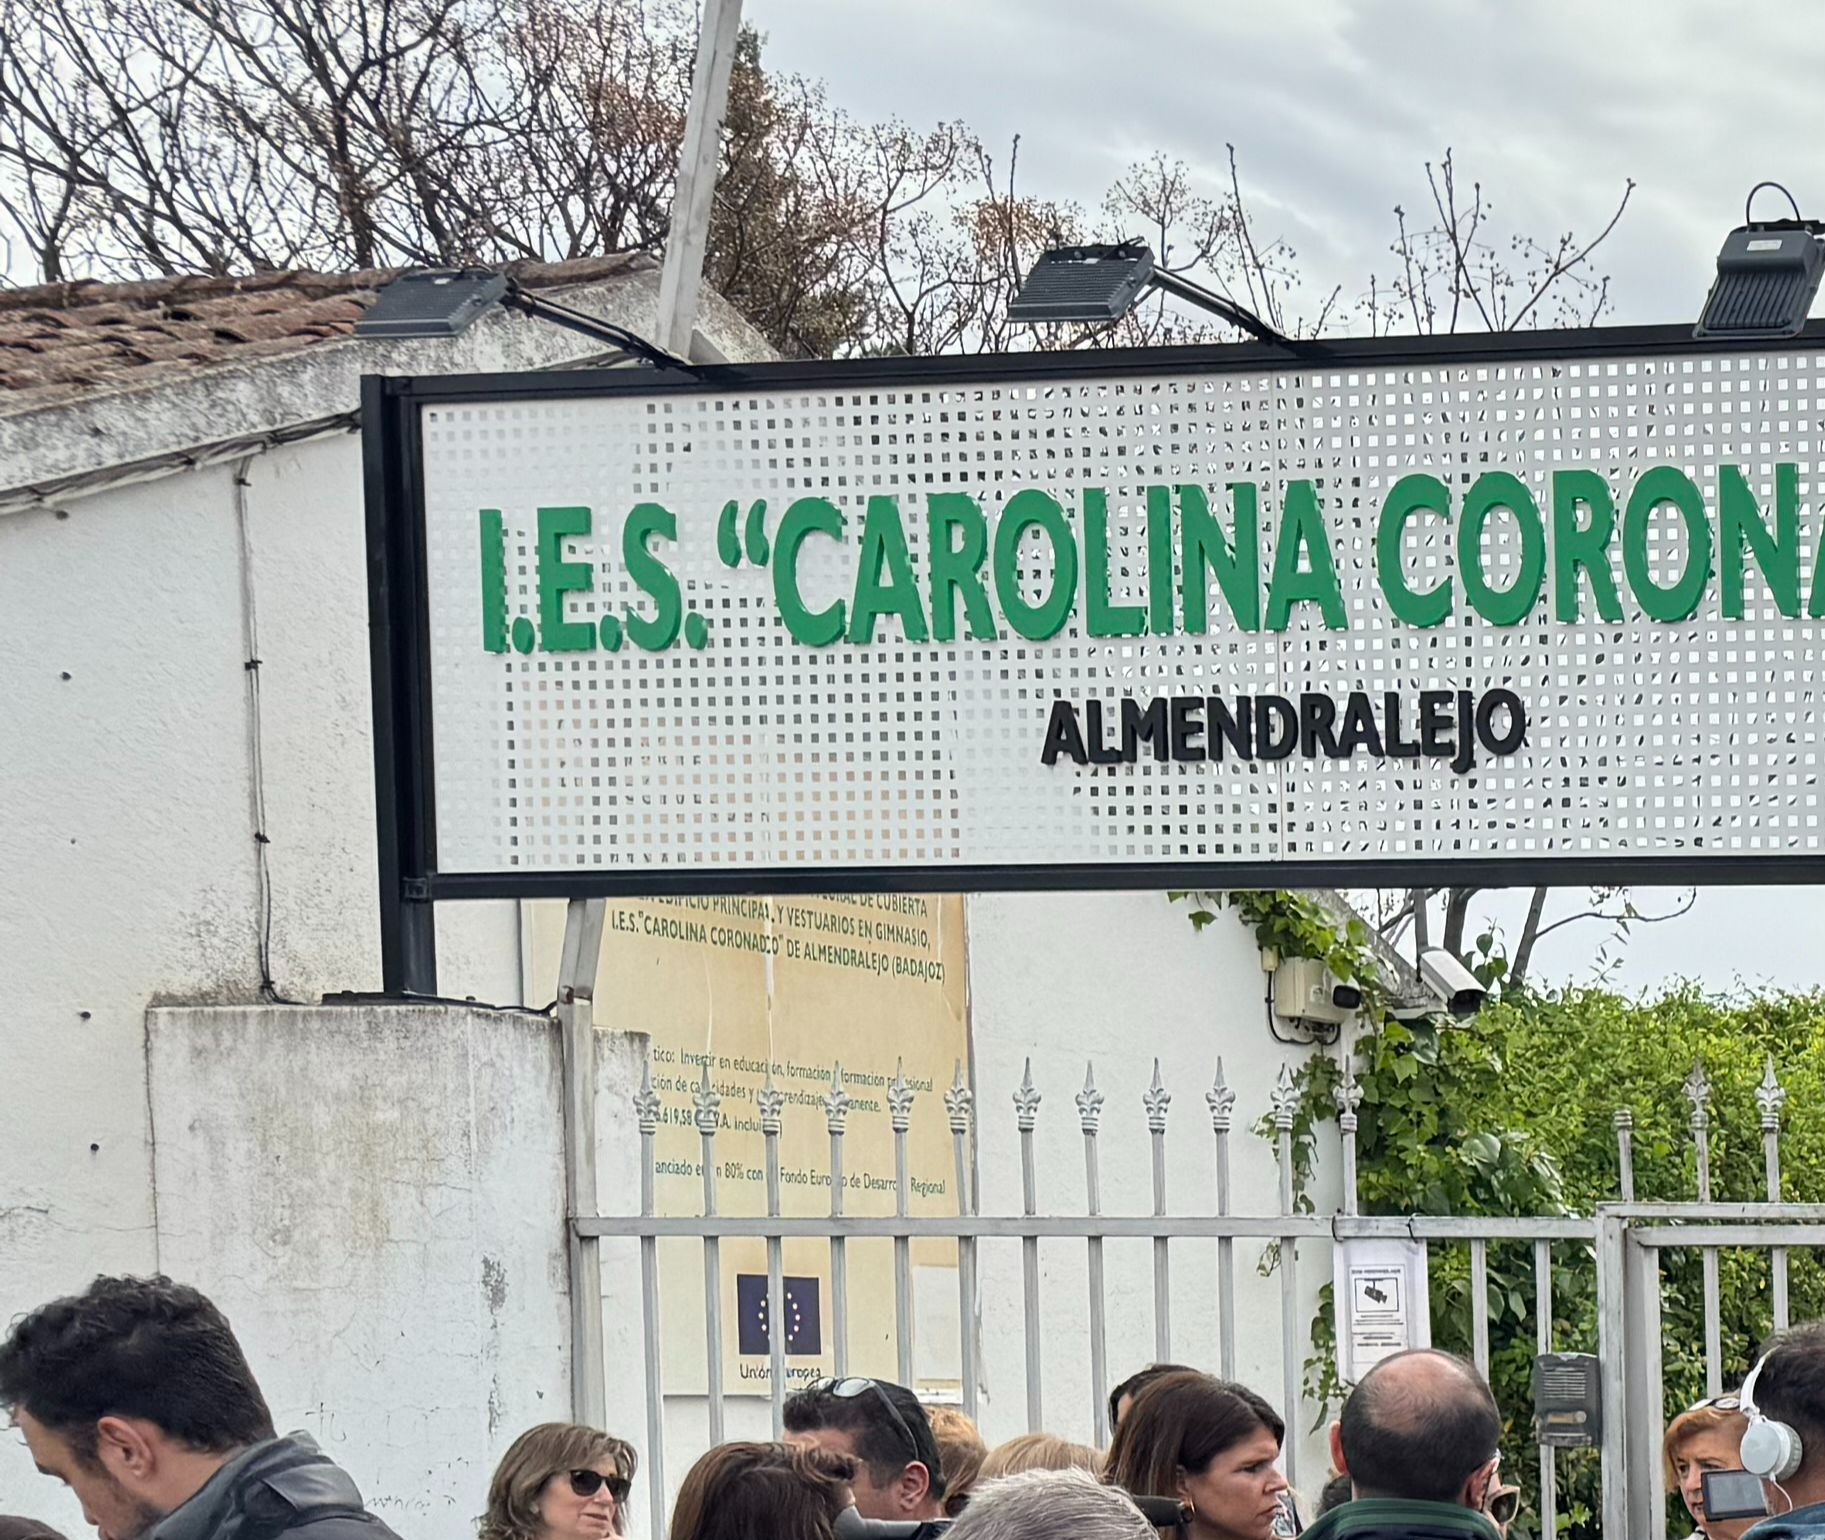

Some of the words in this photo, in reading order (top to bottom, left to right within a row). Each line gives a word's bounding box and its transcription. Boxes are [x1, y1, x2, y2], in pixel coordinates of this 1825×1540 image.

[479, 501, 709, 654] I.E.S.
[1040, 687, 1528, 774] ALMENDRALEJO
[876, 894, 928, 918] CUBIERTA
[612, 909, 640, 933] I.E.S.
[787, 939, 800, 958] DE
[804, 942, 889, 976] ALMENDRALEJO
[892, 955, 946, 985] (BADAJOZ)
[787, 906, 855, 935] VESTUARIOS
[858, 919, 872, 938] EN
[875, 922, 931, 952] GIMNASIO,
[676, 1075, 688, 1092] de
[719, 1056, 730, 1069] en
[786, 1060, 831, 1082] formación
[725, 1161, 744, 1180] 80%
[747, 1168, 764, 1181] con
[780, 1166, 808, 1184] Fondo
[850, 1172, 861, 1189] de
[911, 1176, 946, 1198] Regional
[785, 1367, 821, 1382] uropea
